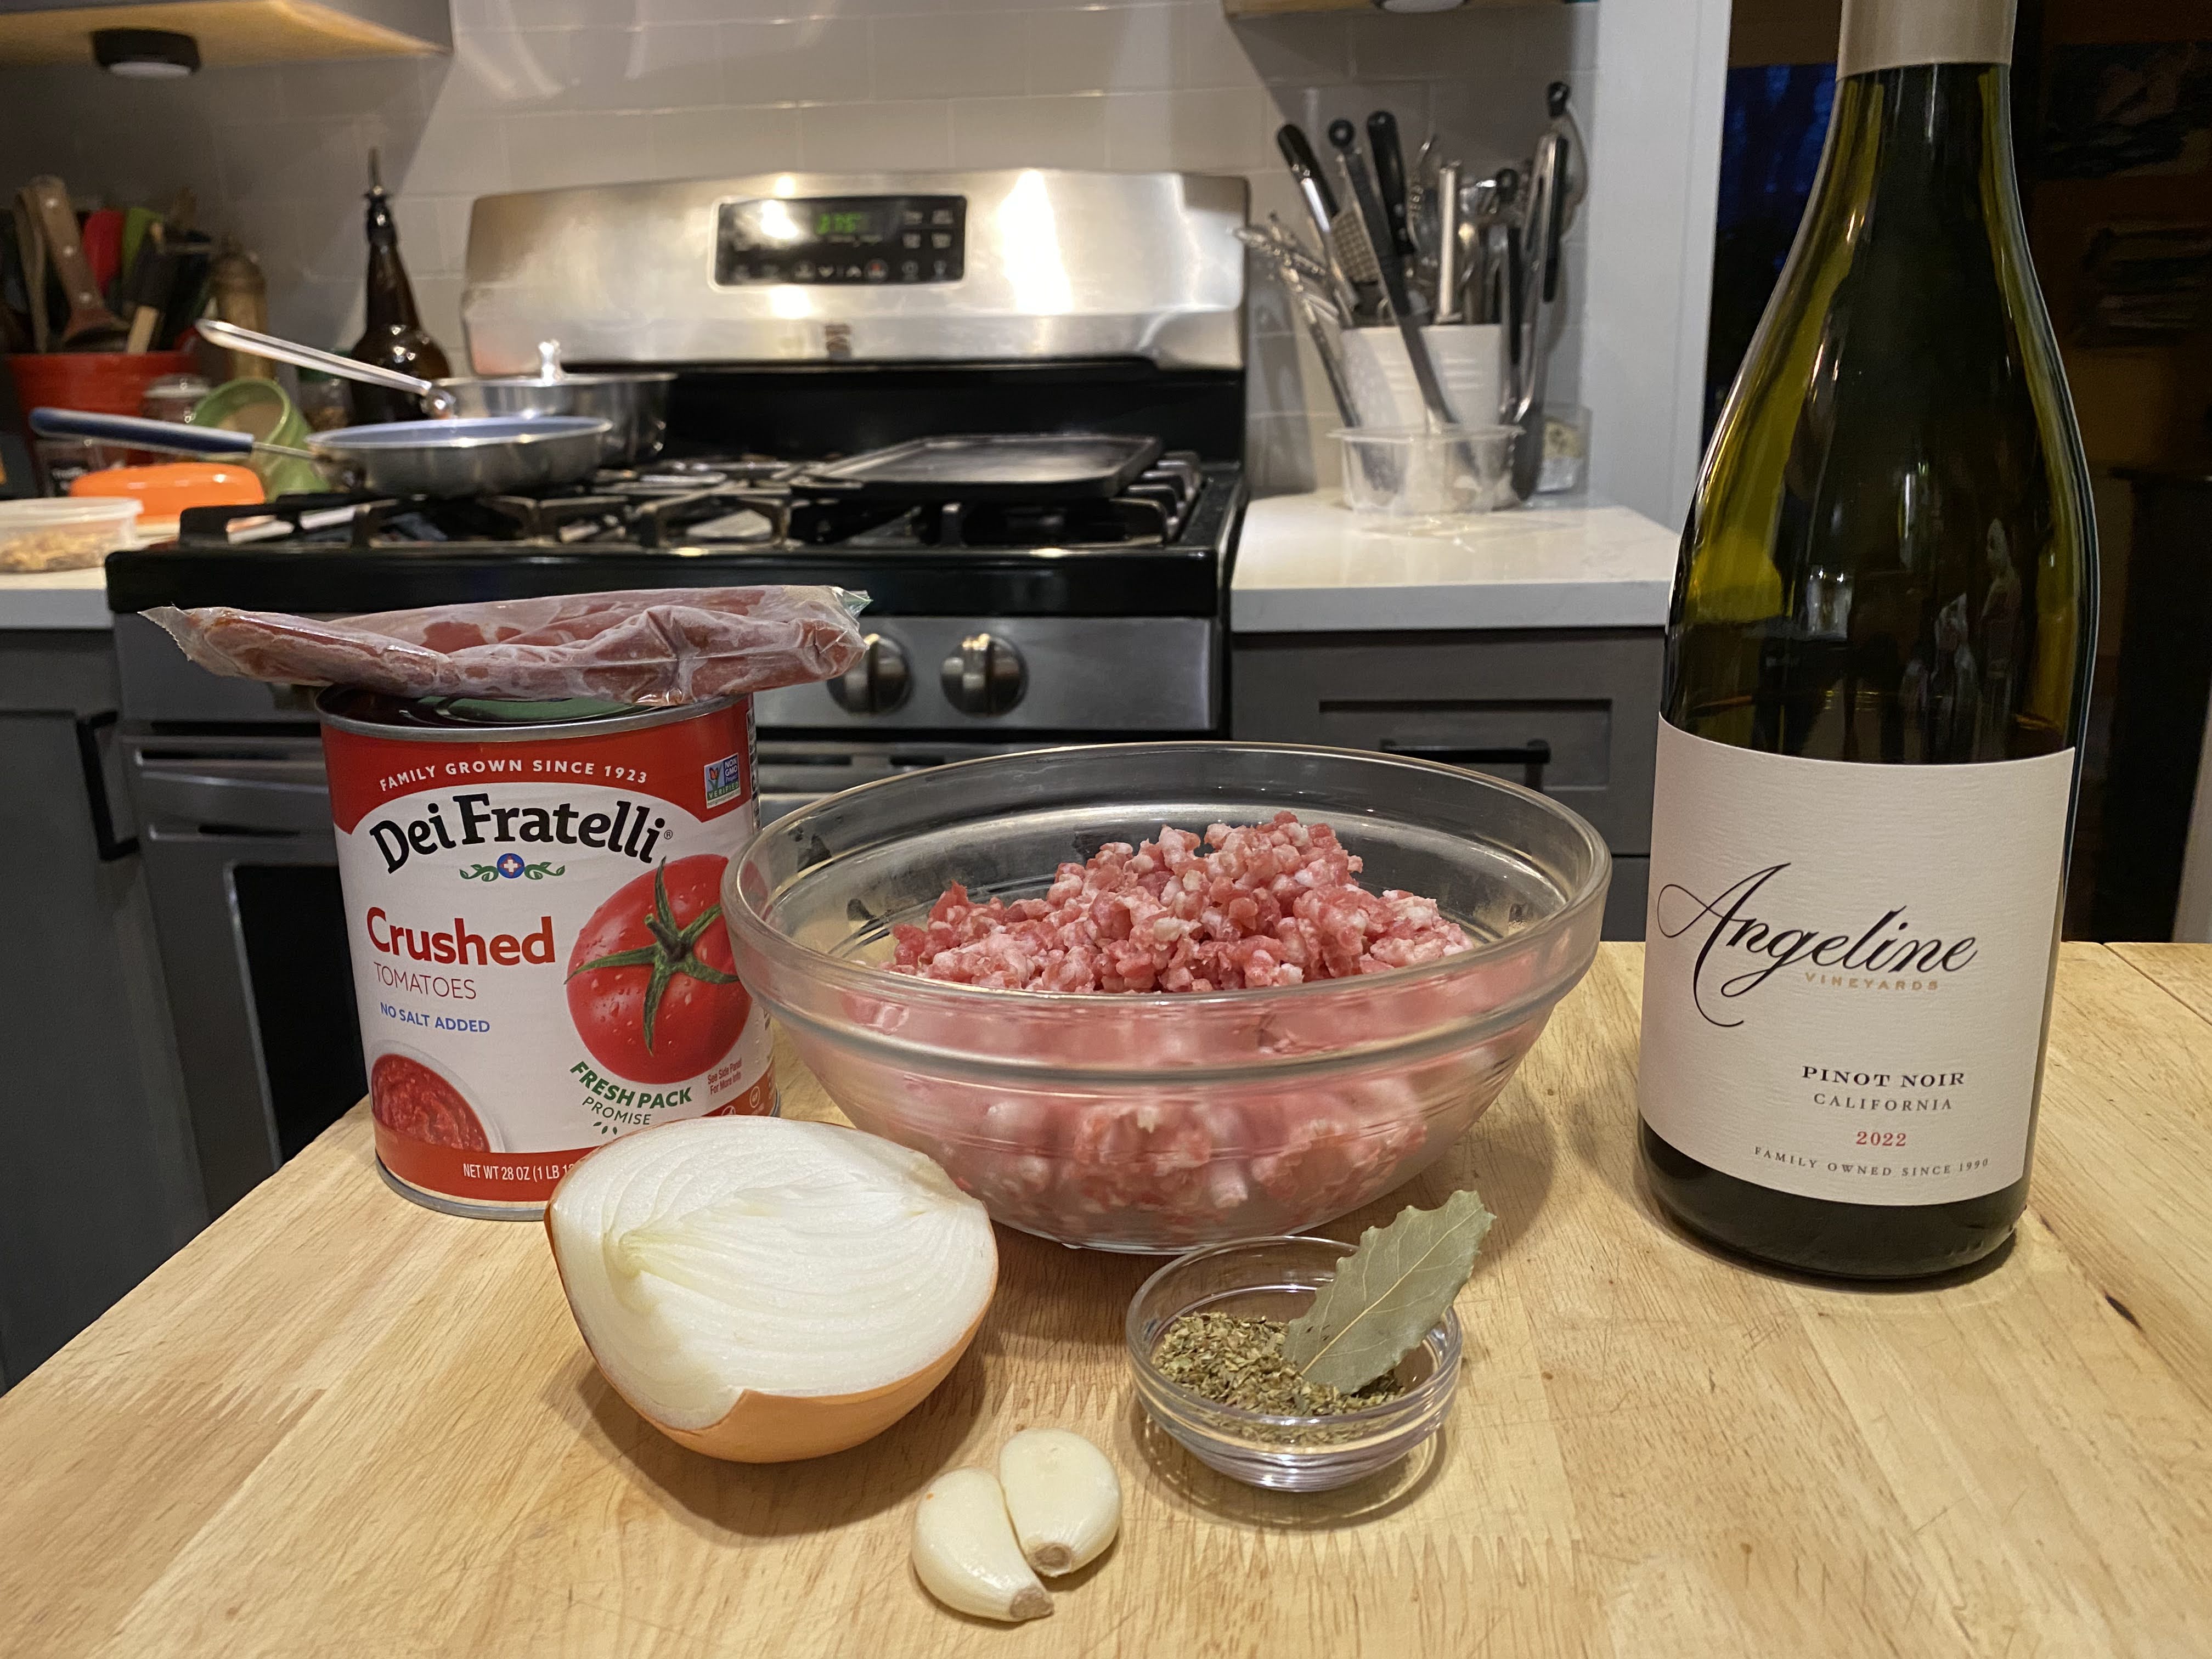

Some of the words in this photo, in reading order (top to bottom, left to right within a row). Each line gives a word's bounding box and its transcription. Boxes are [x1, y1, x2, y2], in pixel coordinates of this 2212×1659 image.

[725, 757, 737, 768] NON
[725, 765, 737, 776] GMO
[379, 765, 436, 792] FAMILY
[445, 760, 522, 775] GROWN
[533, 760, 594, 775] SINCE
[605, 765, 647, 783] 1923
[709, 781, 738, 799] VERIFIED
[369, 803, 457, 874] Dei
[366, 906, 555, 966] Crushed
[1657, 862, 1977, 1027] Angeline
[373, 961, 476, 1000] TOMATOES
[1805, 973, 1939, 991] VINEYARDS
[380, 1002, 396, 1018] NO
[399, 1009, 430, 1027] SALT
[435, 1017, 490, 1033] ADDED
[569, 1061, 635, 1107] FRESH
[637, 1087, 692, 1109] PACK
[708, 1074, 718, 1085] See
[1802, 1065, 1890, 1087] PINOT
[1900, 1073, 1965, 1088] NOIR
[710, 1084, 719, 1095] For
[582, 1097, 651, 1125] PROMISE
[1814, 1093, 1952, 1111] CALIFORNIA
[1856, 1131, 1907, 1147] 2022
[463, 1163, 481, 1178] NET
[483, 1165, 499, 1180] WT
[501, 1166, 514, 1181] 28
[516, 1166, 531, 1181] OZ
[533, 1165, 543, 1183] (1
[546, 1165, 560, 1180] LB
[1755, 1146, 1818, 1169] FAMILY
[1827, 1162, 1892, 1176] OWNED
[1901, 1164, 1951, 1177] SINCE
[1959, 1158, 1989, 1172] 1990
